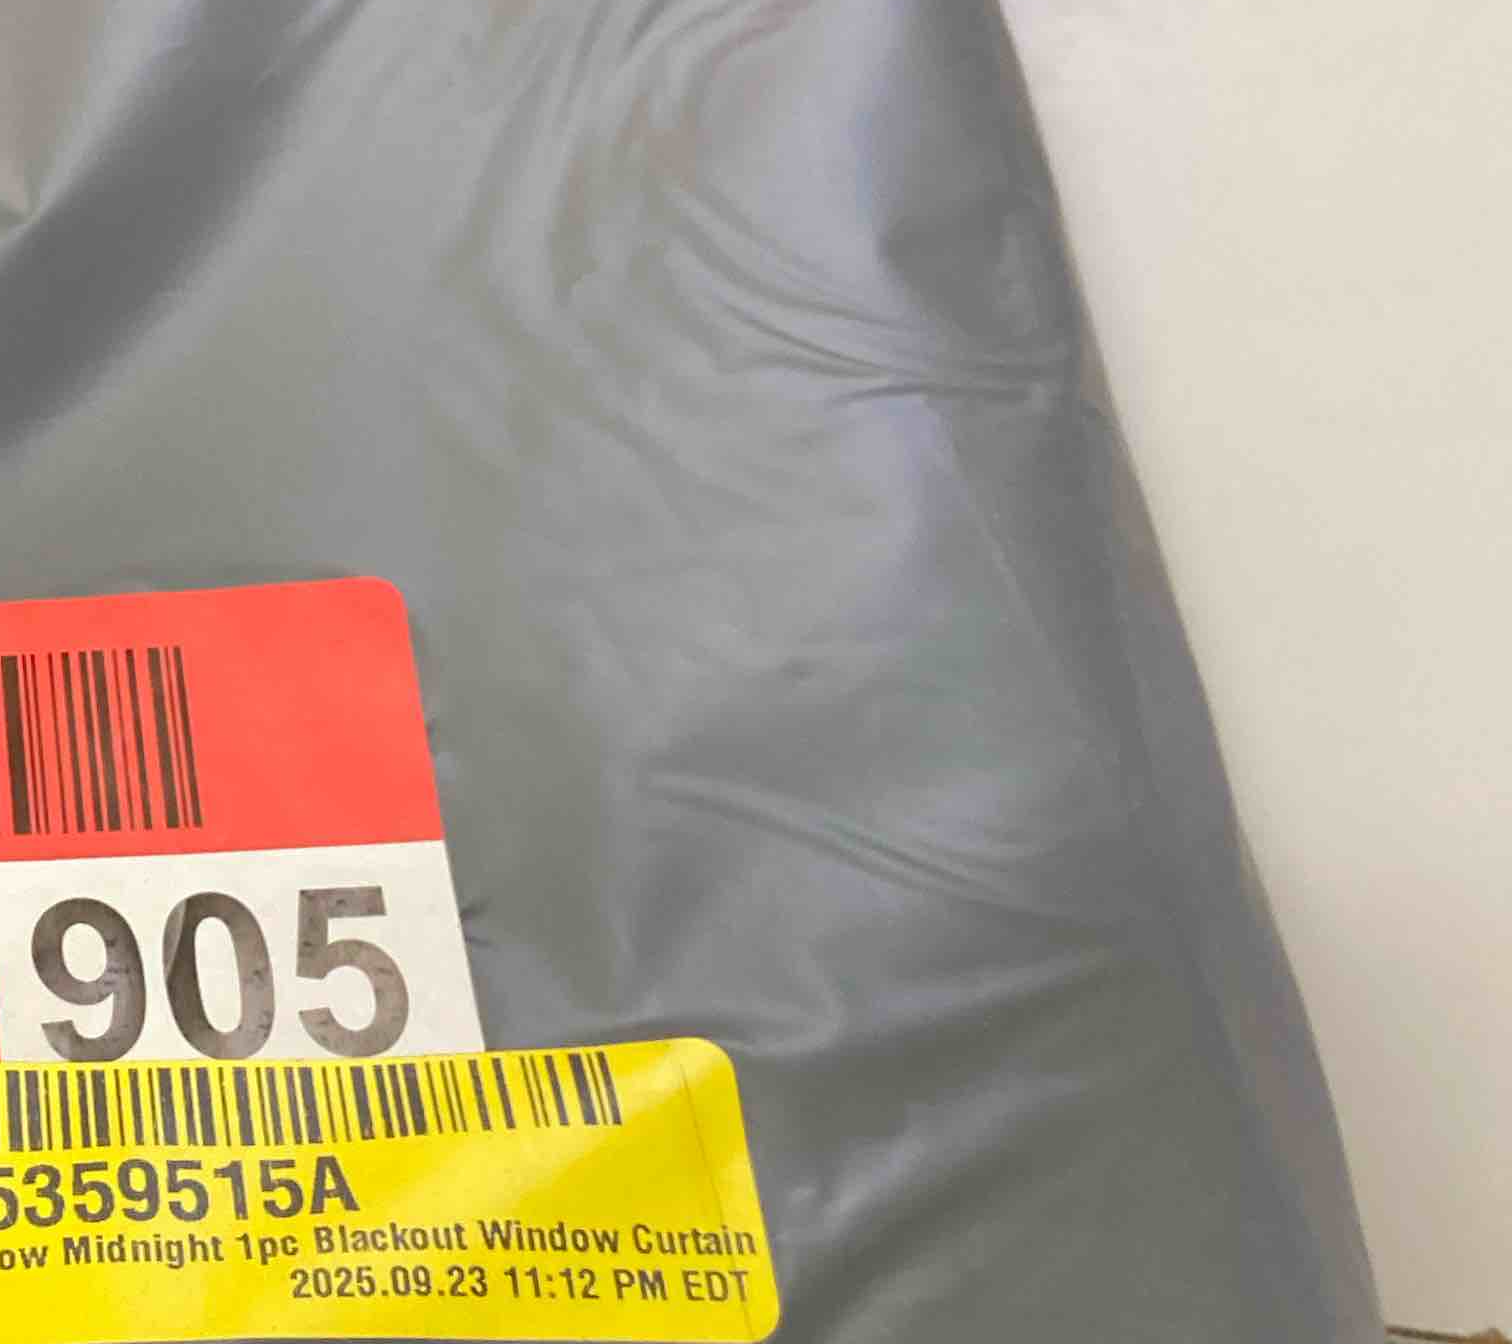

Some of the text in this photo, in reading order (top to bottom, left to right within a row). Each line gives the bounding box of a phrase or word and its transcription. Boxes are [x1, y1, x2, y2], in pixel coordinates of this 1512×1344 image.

[31, 885, 409, 1063] 905
[63, 1233, 225, 1269] Midnight
[235, 1232, 299, 1266] 1pc
[314, 1220, 467, 1255] Blackout
[476, 1219, 619, 1254] Window
[632, 1223, 756, 1256] Curtain
[290, 1266, 751, 1302] 2025.09.23 11:12 PM EDT
